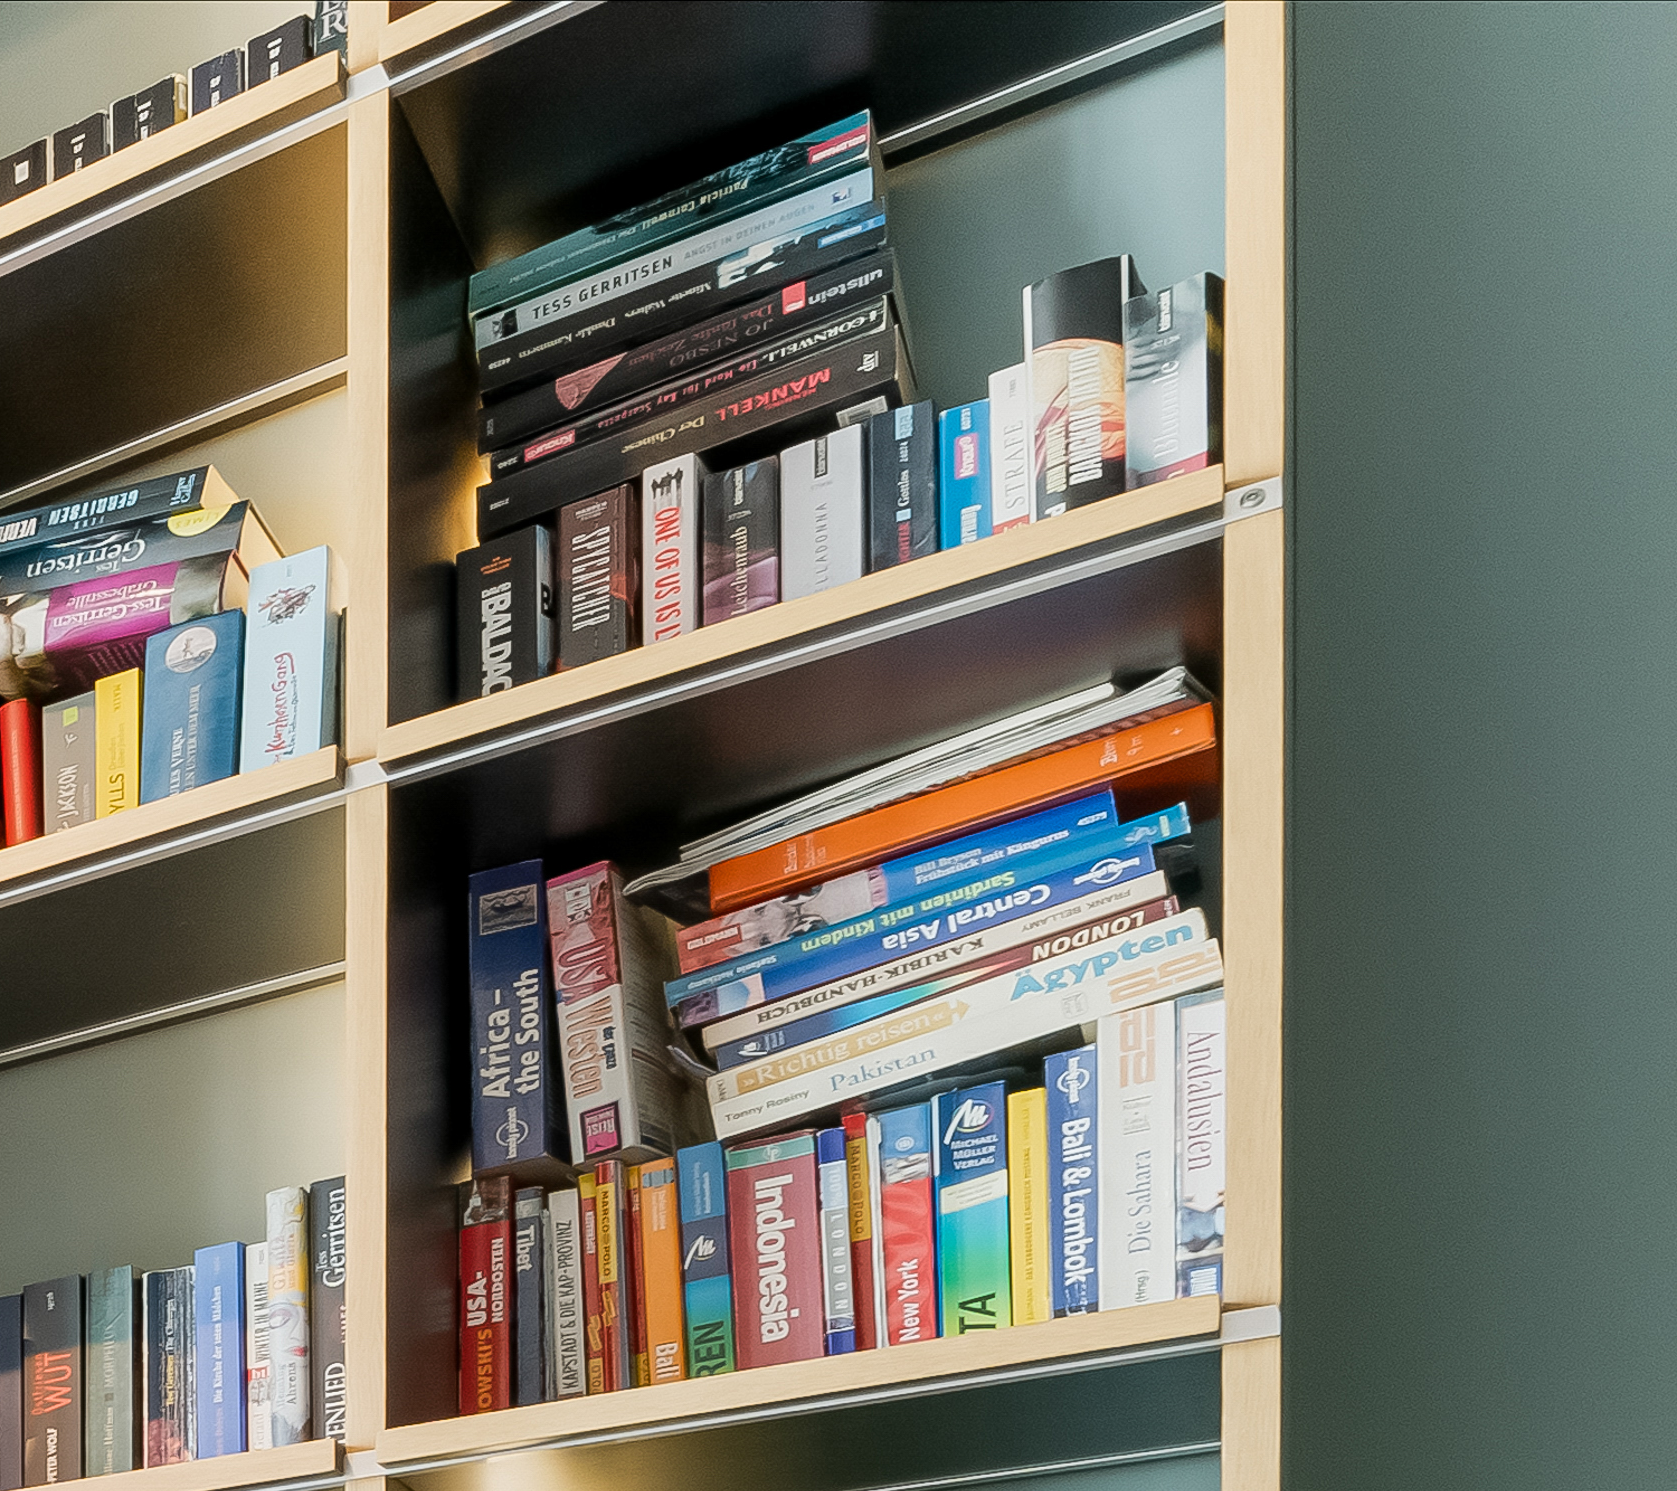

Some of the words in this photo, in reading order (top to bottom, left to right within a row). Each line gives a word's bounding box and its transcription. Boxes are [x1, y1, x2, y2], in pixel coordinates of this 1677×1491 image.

[532, 295, 571, 320] TESS
[578, 255, 673, 303] GERRITSEN
[807, 268, 883, 305] ullstein
[715, 368, 831, 421] MANKELL
[1003, 419, 1024, 509] STRAFE
[655, 507, 680, 545] ONE
[27, 538, 146, 579] Gerritsen
[656, 548, 680, 570] OF
[655, 572, 681, 600] US
[655, 601, 681, 624] IS
[920, 870, 1016, 913] Sardinien
[947, 884, 1051, 934] Central
[802, 916, 880, 951] Kindern
[882, 920, 942, 951] Asia
[883, 905, 915, 925] mit
[1031, 910, 1146, 962] LONDON
[1009, 921, 1194, 1000] Ägypten
[513, 969, 540, 1044] South
[480, 1007, 511, 1098] Africa
[514, 1051, 540, 1094] the
[829, 1047, 936, 1092] Pakistan
[1186, 1032, 1224, 1172] Andalusien
[1061, 1117, 1092, 1163] Bali
[1126, 1150, 1153, 1222] Sahara
[754, 1174, 801, 1344] Indonesia
[1062, 1187, 1095, 1289] Lombok
[1128, 1227, 1153, 1254] Die
[899, 1259, 919, 1308] York
[899, 1311, 919, 1342] New
[560, 1335, 578, 1389] KAPSTADT
